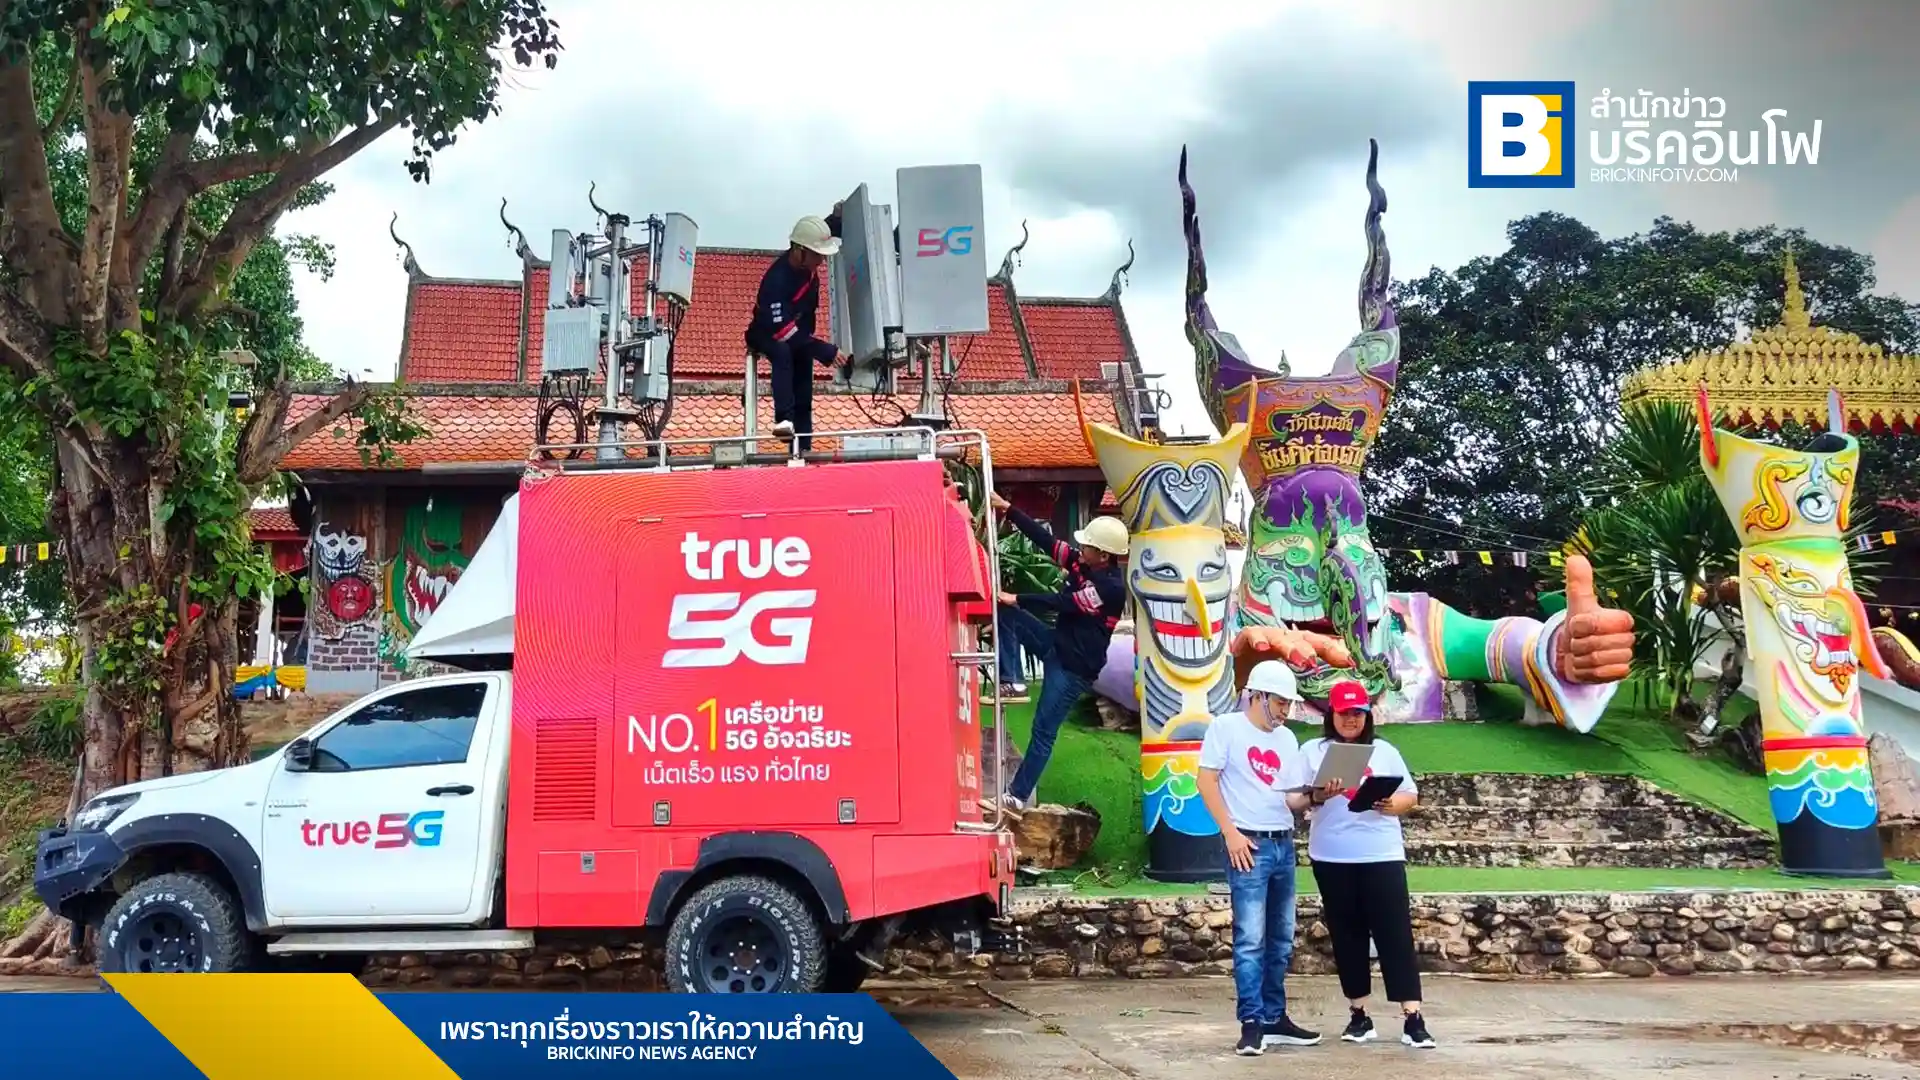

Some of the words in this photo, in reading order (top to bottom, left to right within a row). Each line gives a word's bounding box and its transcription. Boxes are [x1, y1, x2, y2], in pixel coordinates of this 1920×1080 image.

[916, 225, 974, 258] 5G
[680, 532, 812, 580] true
[661, 589, 818, 668] 5G
[725, 699, 824, 725] เครือข่าย
[725, 729, 758, 750] 5G
[763, 725, 852, 750] อัจฉริยะ
[643, 760, 715, 785] เน็ตเร็ว
[720, 765, 760, 784] แรง
[764, 756, 831, 783] ทั่วไทย
[301, 819, 372, 847] true
[374, 810, 445, 850] 5G
[748, 896, 801, 981] BIGHORN
